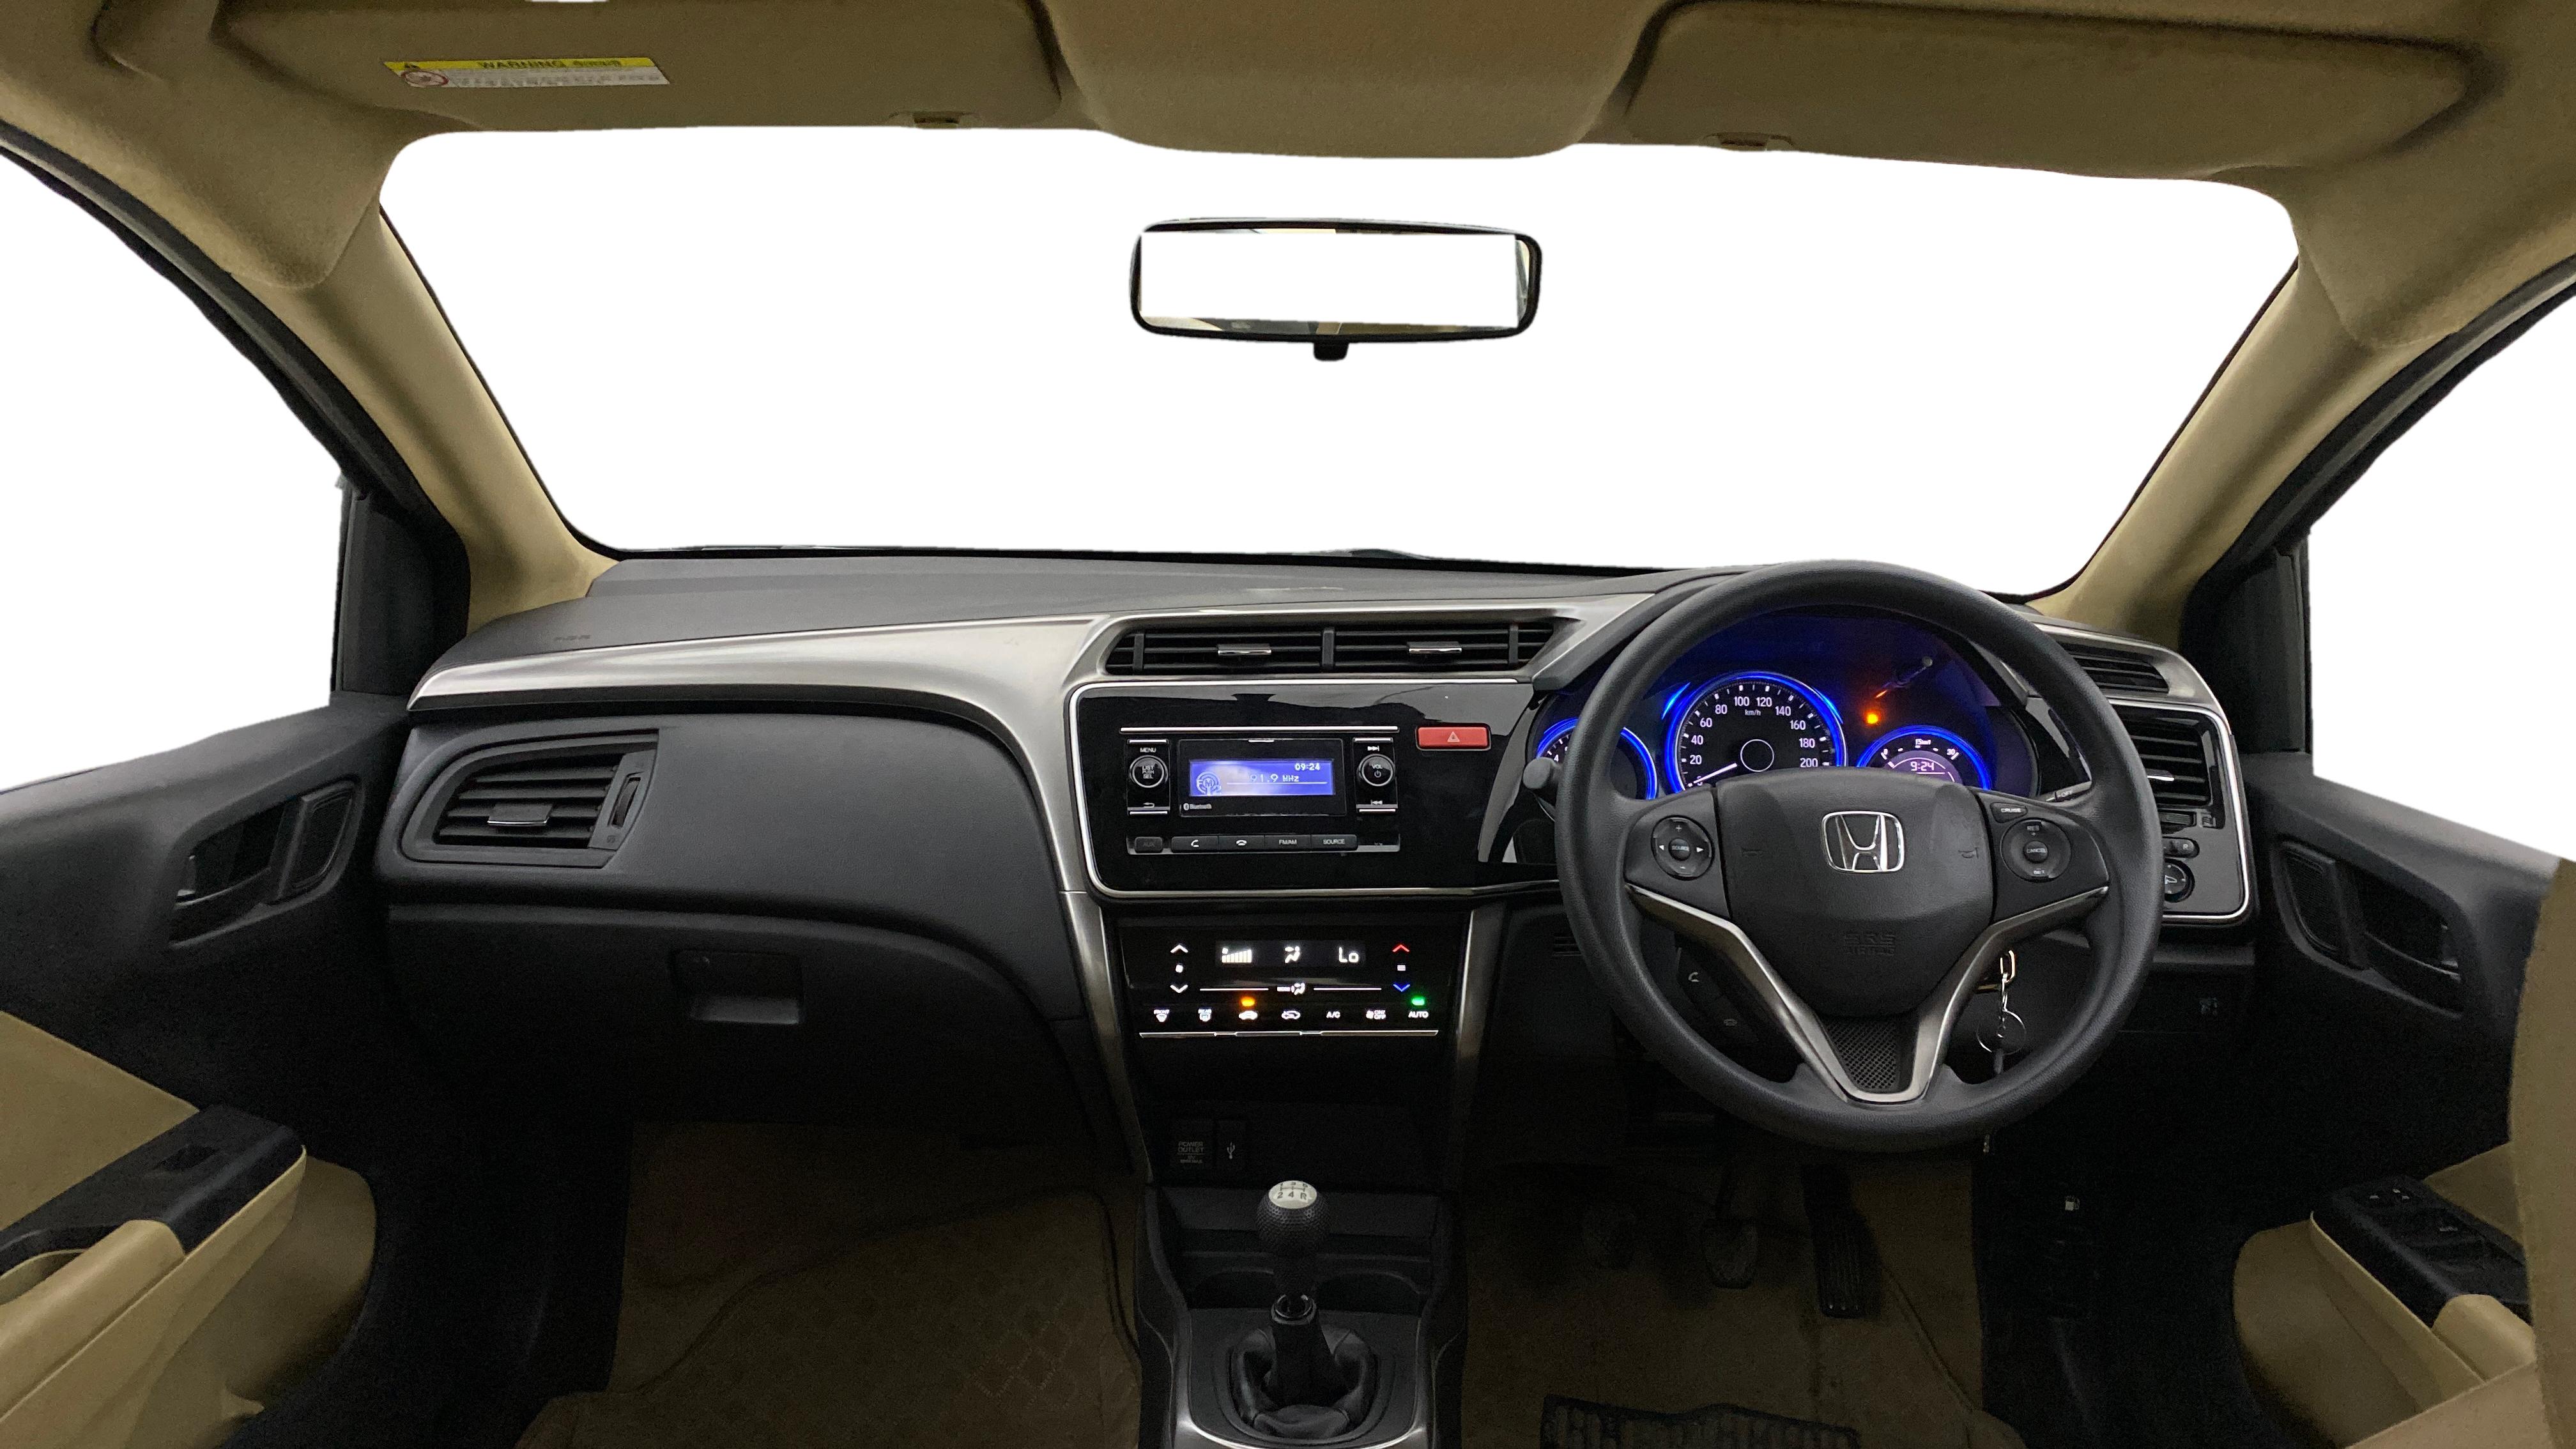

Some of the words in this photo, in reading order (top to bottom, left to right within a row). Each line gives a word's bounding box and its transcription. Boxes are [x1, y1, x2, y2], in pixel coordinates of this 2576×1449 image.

[1734, 696, 1750, 707] 100
[1756, 696, 1772, 707] 120
[1715, 704, 1728, 715] 80
[1745, 709, 1761, 717] km/h
[1775, 705, 1791, 716] 140
[1699, 717, 1713, 728] 60
[1790, 720, 1806, 730] 160
[1690, 735, 1704, 746] 40
[1799, 738, 1816, 748] 180
[1689, 755, 1702, 765] 20
[1800, 758, 1818, 768] 200
[1294, 762, 1321, 771] 09:24
[1910, 761, 1935, 771] 9:24
[1250, 773, 1278, 783] 91.9
[1338, 946, 1359, 963] Lo
[1326, 1011, 1341, 1019] A/C
[1300, 1192, 1307, 1200] R
